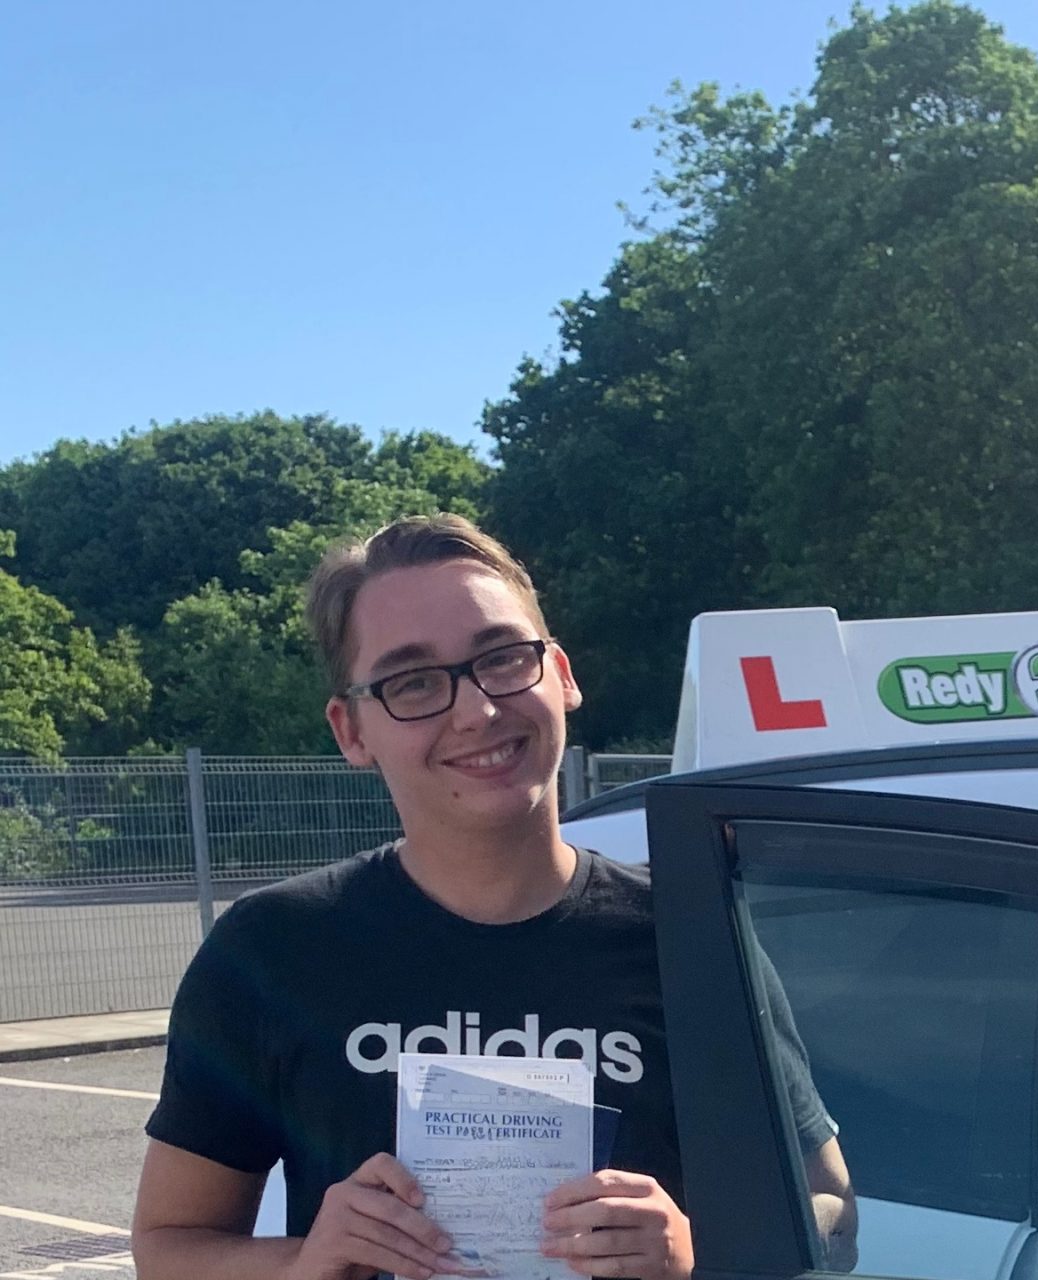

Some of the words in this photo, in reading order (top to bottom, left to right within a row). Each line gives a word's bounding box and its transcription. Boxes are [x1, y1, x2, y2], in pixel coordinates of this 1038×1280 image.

[739, 655, 828, 732] L
[899, 663, 1004, 714] Redy
[345, 1010, 645, 1084] adidas
[425, 1111, 497, 1125] PRACTICAL
[502, 1113, 562, 1127] DRIVING
[425, 1125, 451, 1136] TEST
